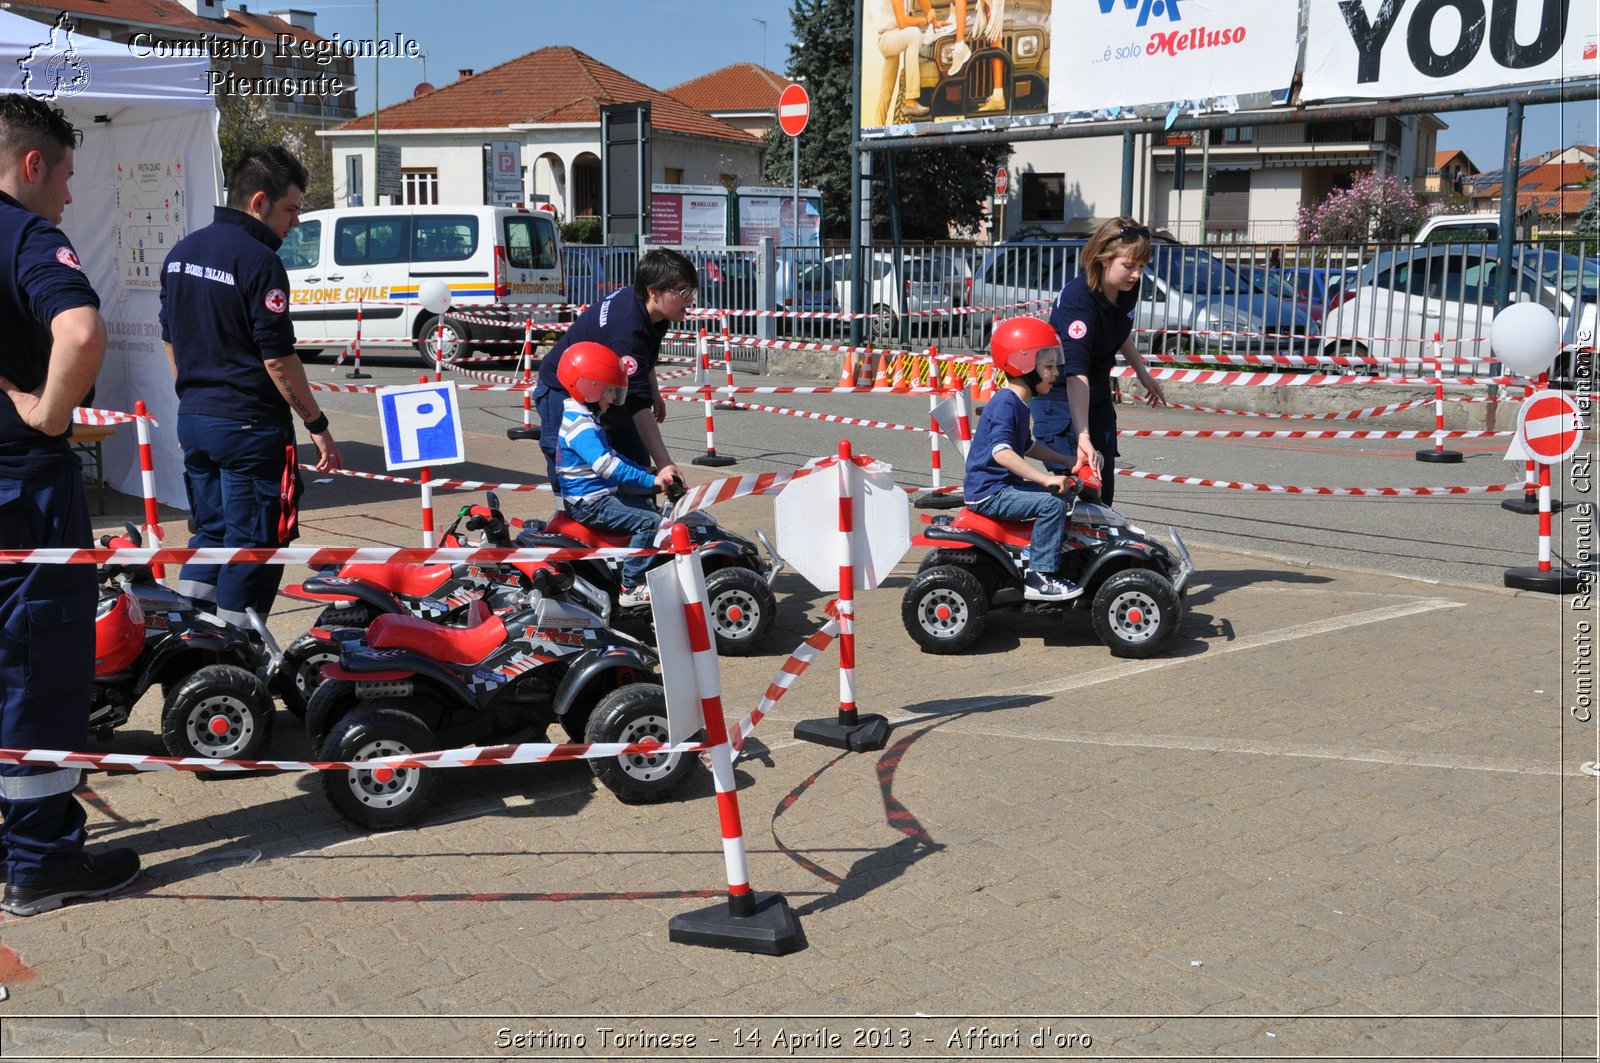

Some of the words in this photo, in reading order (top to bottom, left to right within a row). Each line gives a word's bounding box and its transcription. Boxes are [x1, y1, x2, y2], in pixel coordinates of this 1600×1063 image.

[1115, 42, 1141, 60] solo
[1145, 26, 1247, 57] Melluso
[1337, 0, 1570, 84] YOU
[345, 286, 389, 302] CIVILE
[512, 282, 544, 294] PROTEZIONE
[544, 283, 559, 295] CIVILE
[394, 390, 447, 461] P
